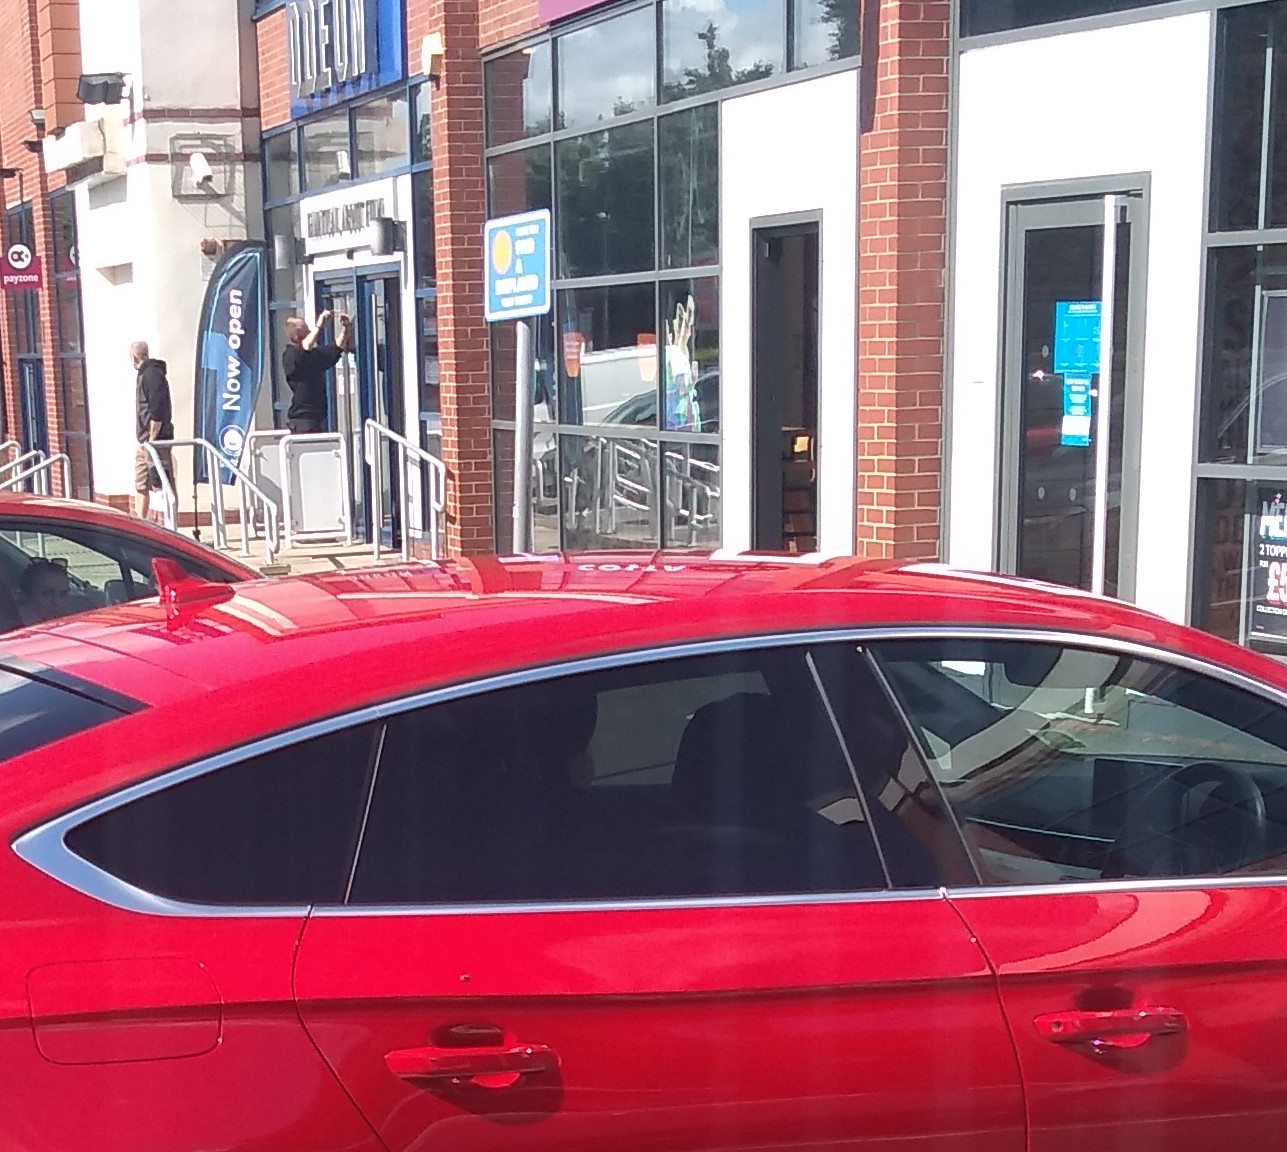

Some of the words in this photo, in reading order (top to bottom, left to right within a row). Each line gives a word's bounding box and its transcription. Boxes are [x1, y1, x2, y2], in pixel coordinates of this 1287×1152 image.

[4, 274, 38, 285] payzone
[228, 289, 245, 350] open
[222, 355, 241, 411] Now
[1259, 543, 1265, 555] 2
